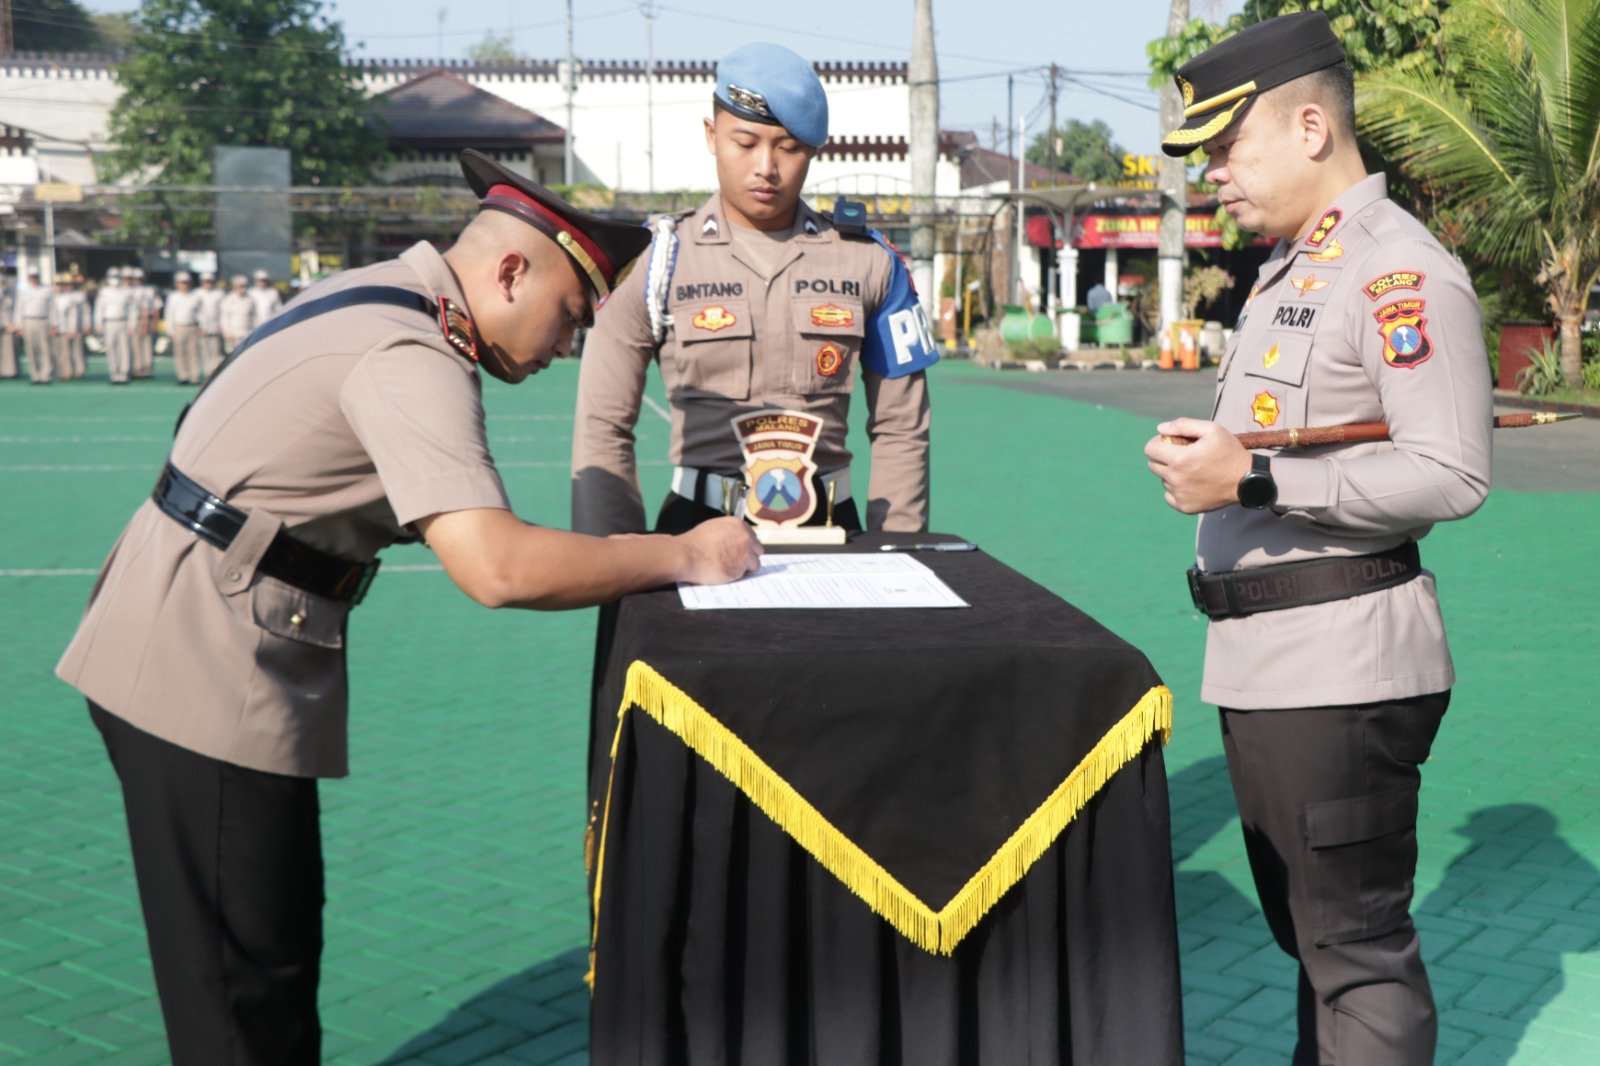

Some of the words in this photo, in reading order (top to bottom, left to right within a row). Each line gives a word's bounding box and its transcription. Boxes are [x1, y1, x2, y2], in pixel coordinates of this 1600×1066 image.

[1122, 153, 1158, 176] SK
[1096, 218, 1138, 233] ZONA
[795, 280, 860, 298] POLRI
[1369, 273, 1417, 292] POLRES
[1375, 279, 1413, 294] MALANG
[676, 282, 743, 302] BINTANG
[1272, 306, 1315, 329] POLRI
[1378, 305, 1396, 317] JAWA
[1397, 301, 1421, 310] TIMUR
[745, 416, 809, 428] POLRES
[755, 424, 801, 432] MALANG
[753, 441, 775, 451] JAWA
[777, 441, 803, 451] TIMUR
[1236, 575, 1298, 601] POLRI
